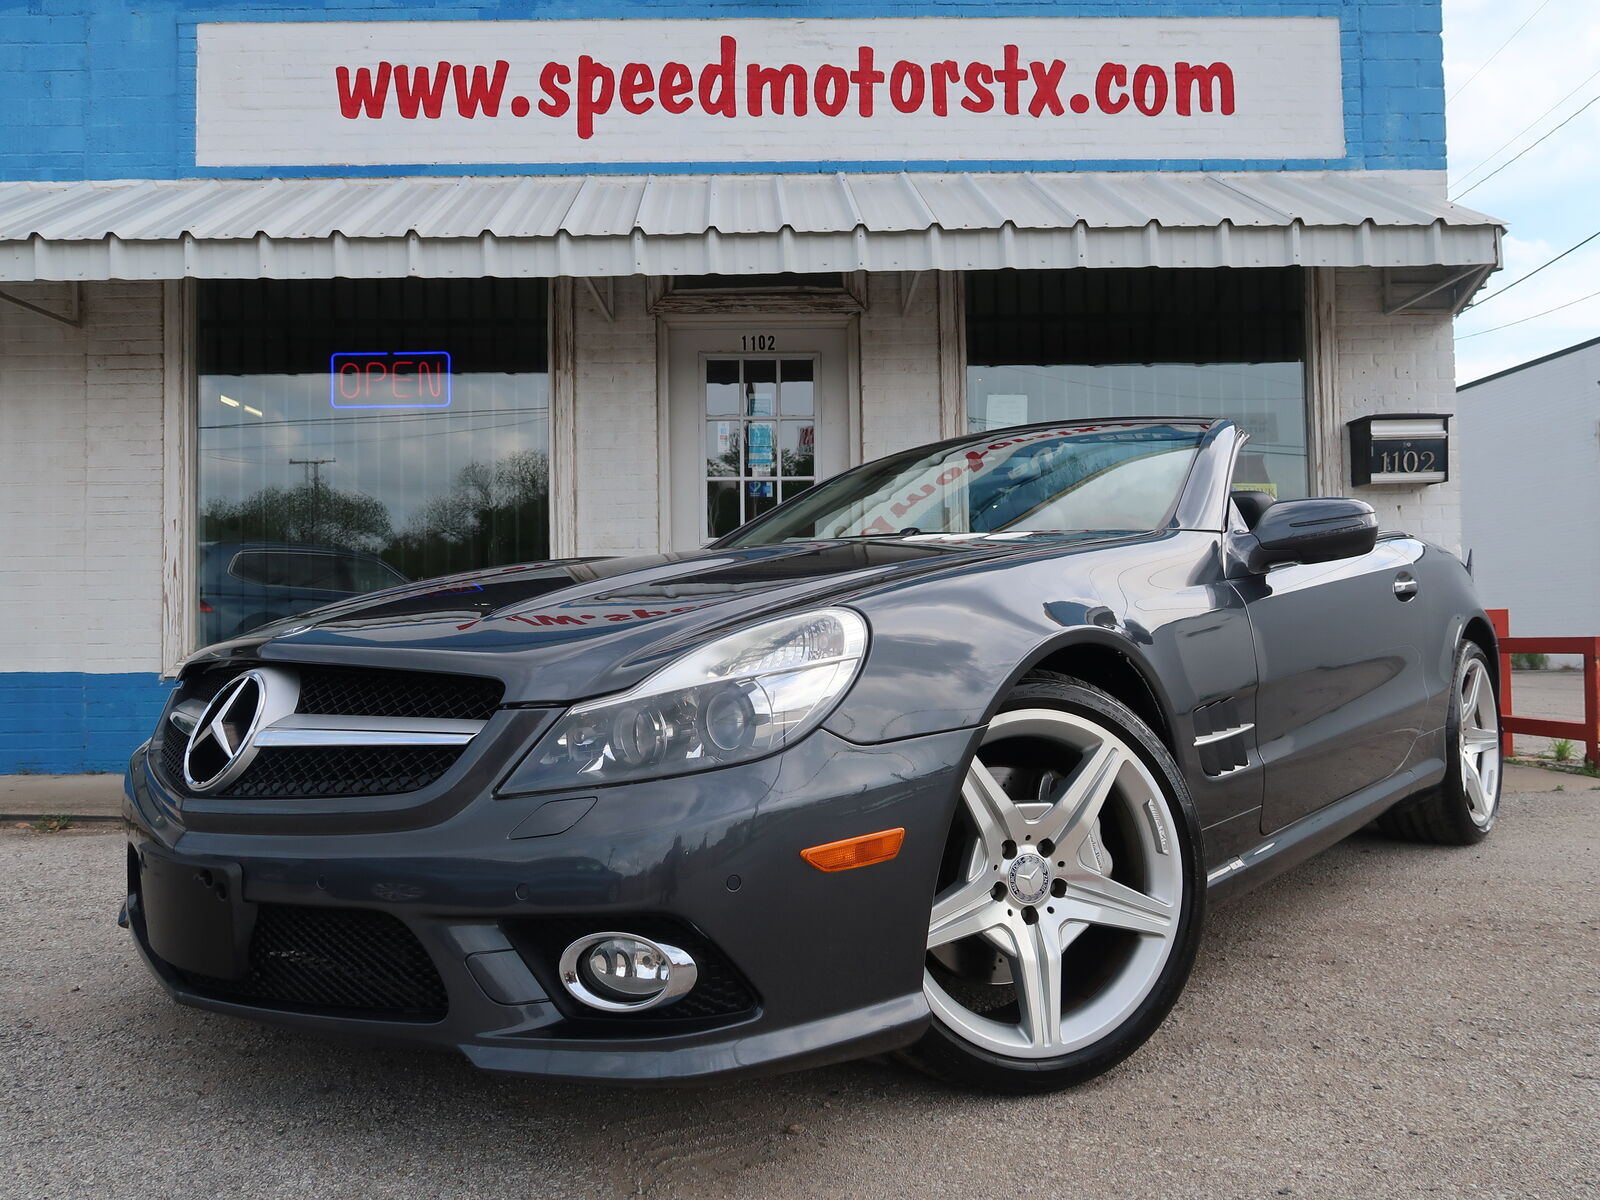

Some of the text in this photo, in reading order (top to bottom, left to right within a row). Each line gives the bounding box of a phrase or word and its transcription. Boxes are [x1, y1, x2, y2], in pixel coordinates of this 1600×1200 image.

[336, 36, 1235, 139] www.speedmotorstx.com
[741, 334, 776, 351] 1102
[340, 361, 441, 399] OPEN
[1380, 450, 1436, 474] 1102
